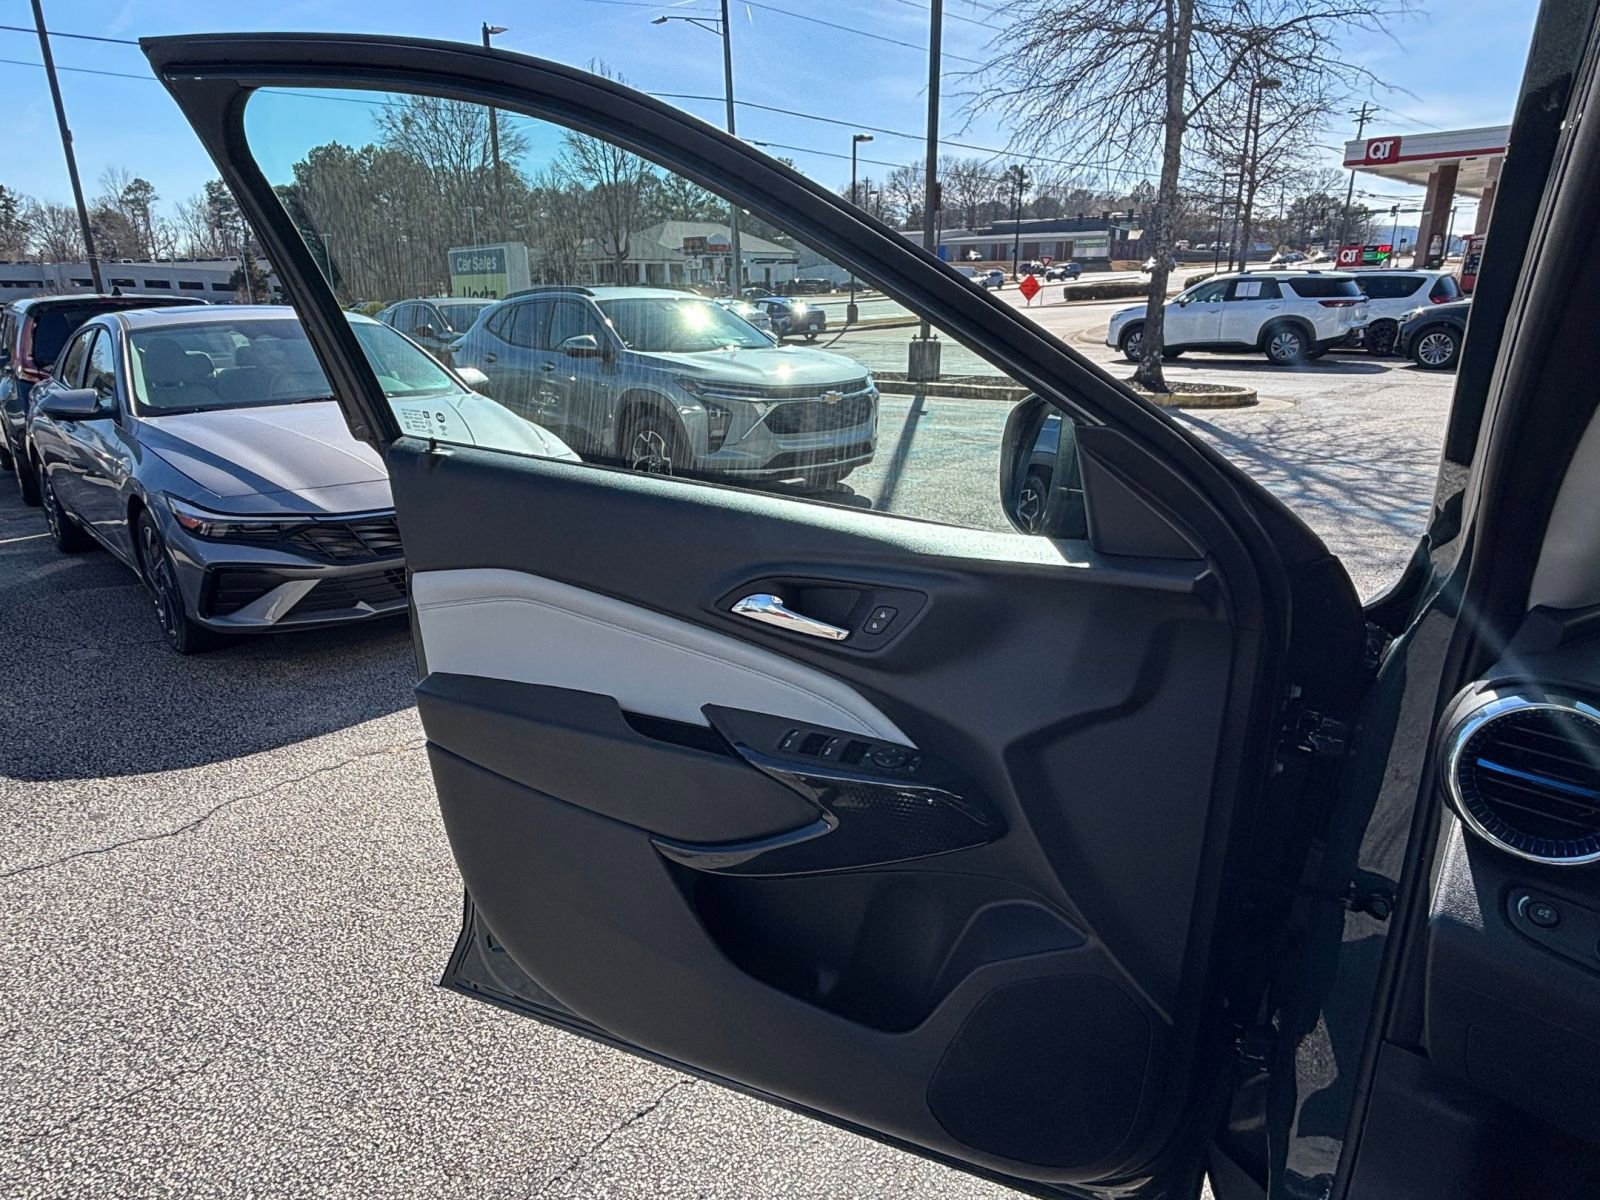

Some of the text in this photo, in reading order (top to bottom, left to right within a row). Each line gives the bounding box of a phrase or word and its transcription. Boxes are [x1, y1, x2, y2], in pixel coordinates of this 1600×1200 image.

[1368, 140, 1394, 160] QT
[456, 255, 497, 271] Car Sales
[1340, 249, 1359, 263] QT
